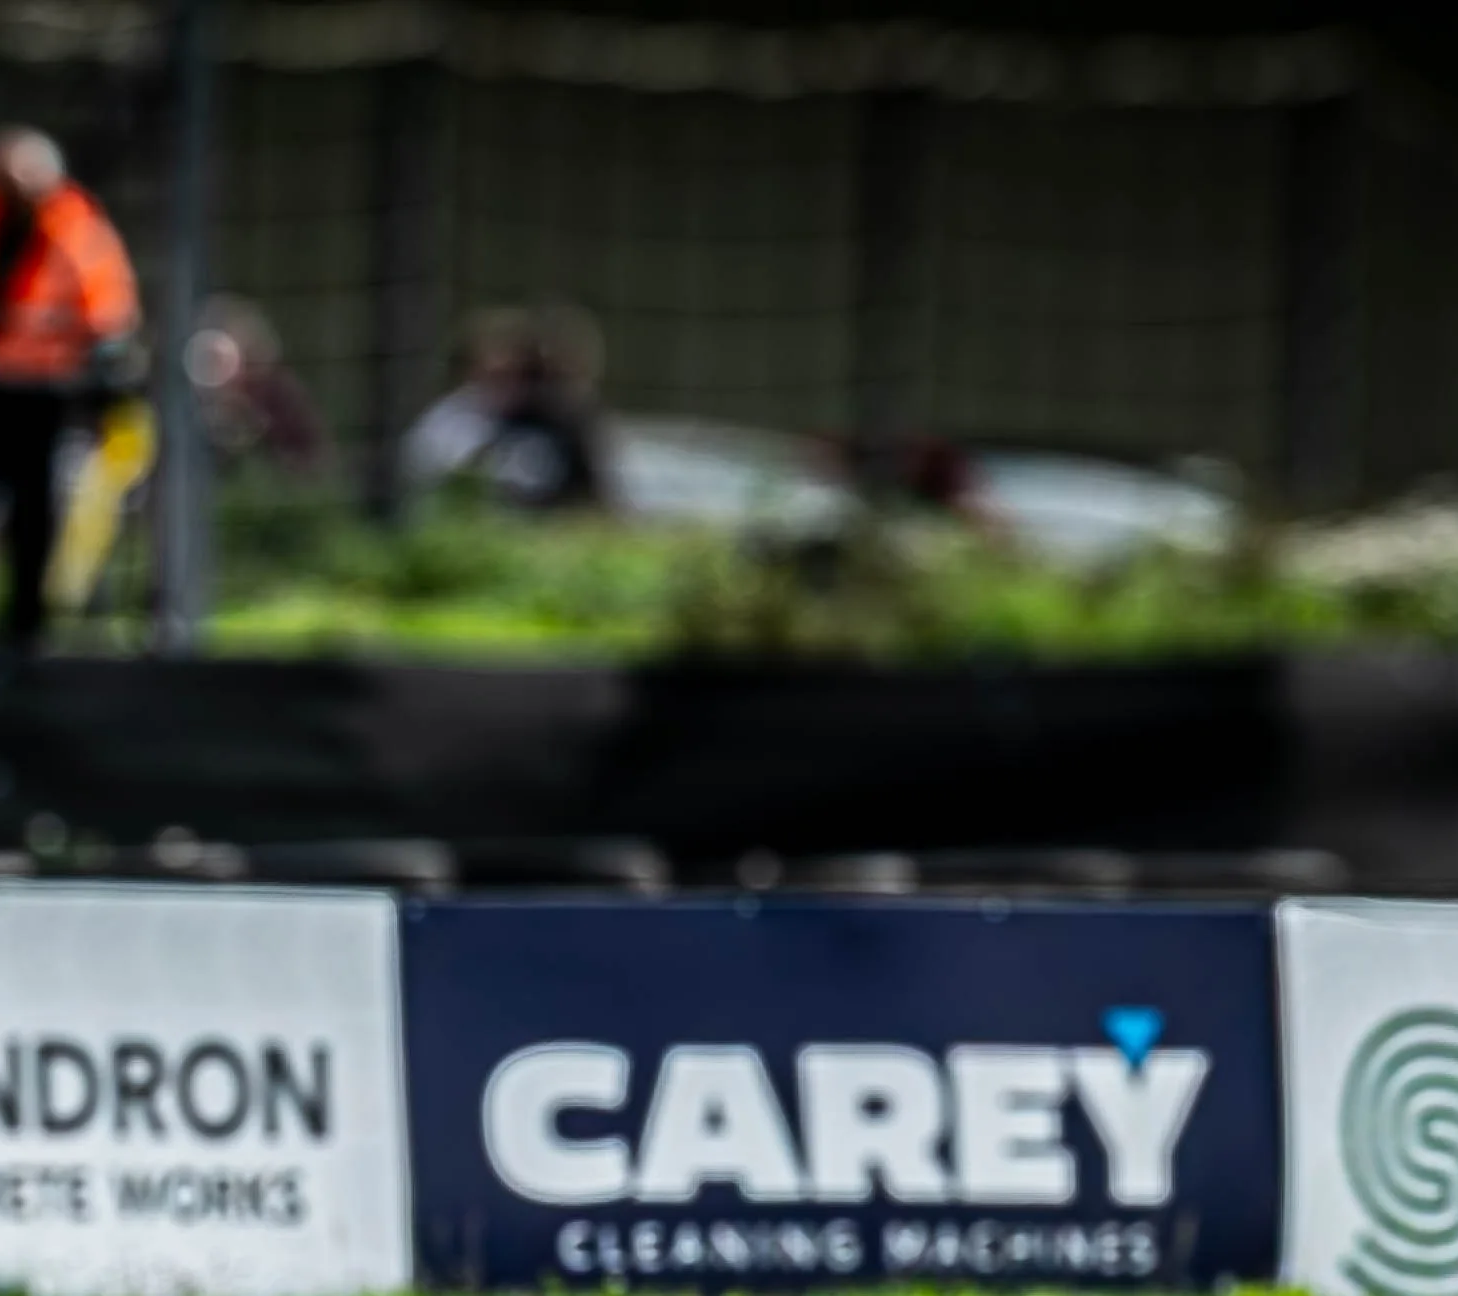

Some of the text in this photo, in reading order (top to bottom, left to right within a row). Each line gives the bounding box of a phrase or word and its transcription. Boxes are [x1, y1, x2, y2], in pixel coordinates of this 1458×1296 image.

[482, 1040, 1212, 1204] CAREY
[110, 1164, 312, 1226] WORKS
[554, 1218, 1160, 1276] CLEANING MACHINES
